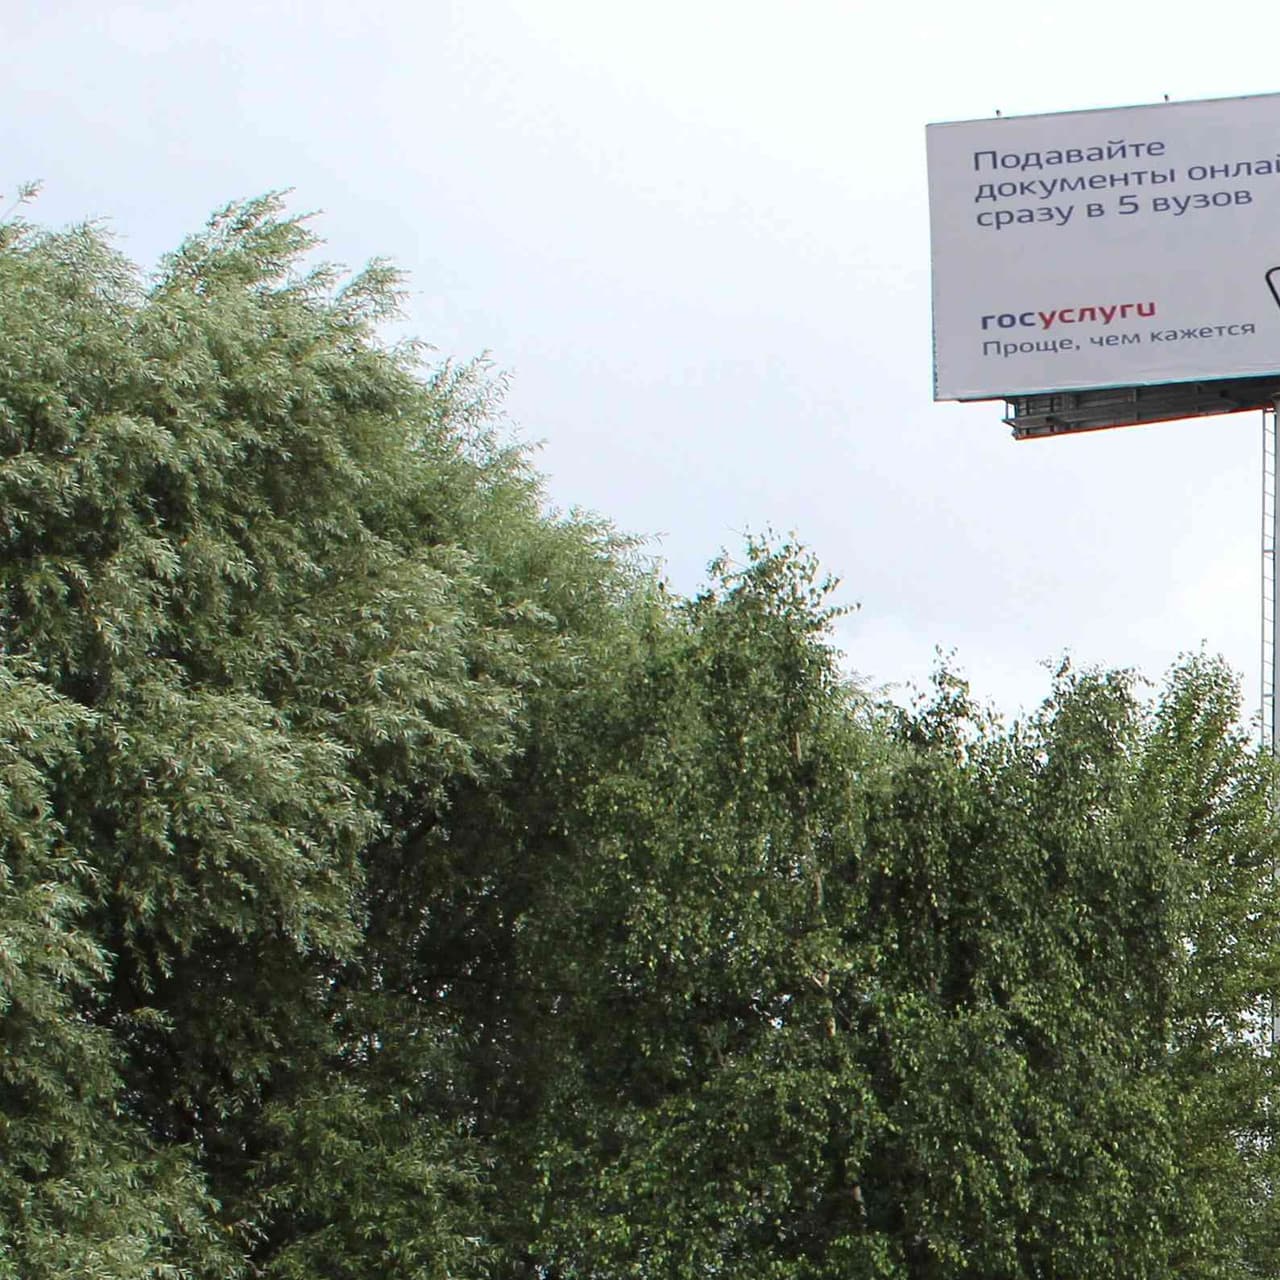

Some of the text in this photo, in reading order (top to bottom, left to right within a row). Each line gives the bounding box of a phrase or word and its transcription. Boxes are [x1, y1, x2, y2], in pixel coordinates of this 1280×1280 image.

[973, 139, 1166, 171] Подавайте
[974, 168, 1175, 203] документы
[976, 190, 1254, 230] сразу в 5 вузов
[980, 301, 1157, 330] госуслуги
[983, 322, 1256, 358] Проще, чем кажется
